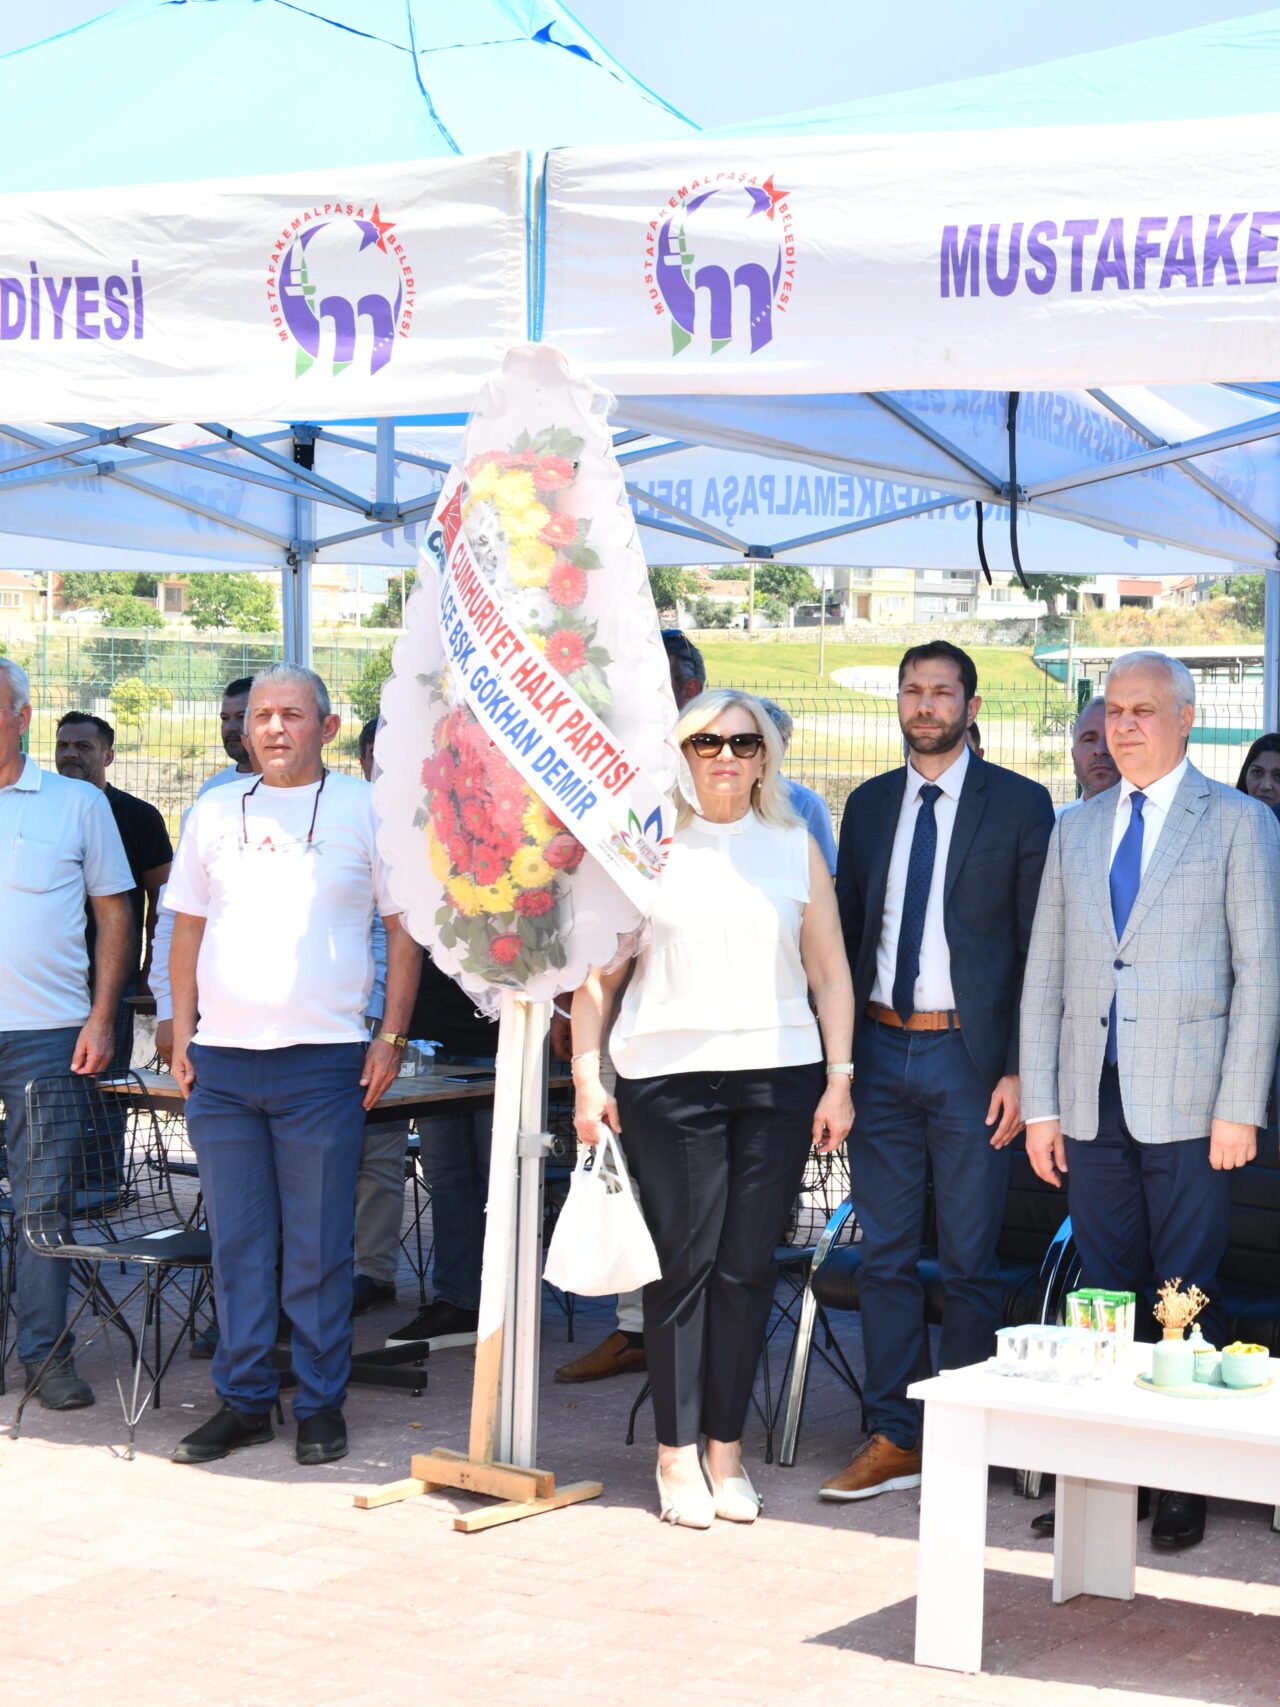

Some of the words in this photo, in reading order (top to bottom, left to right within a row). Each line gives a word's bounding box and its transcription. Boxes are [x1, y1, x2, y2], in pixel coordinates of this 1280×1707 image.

[0, 259, 144, 341] DİYESİ
[266, 203, 365, 342] MUSTAFAKEMALPAŞA
[387, 234, 416, 339] BELEDİYESİ
[644, 172, 759, 316] MUSTAFAKEMALPAŞA
[777, 203, 798, 313] BELEDİYESİ
[449, 618, 477, 676] BŞK.
[469, 665, 543, 758] GÖKHAN
[531, 746, 598, 822] DEMİR
[451, 542, 526, 668] CUMHURİYET
[510, 656, 572, 725] HALK
[556, 709, 641, 797] PARTİSİ
